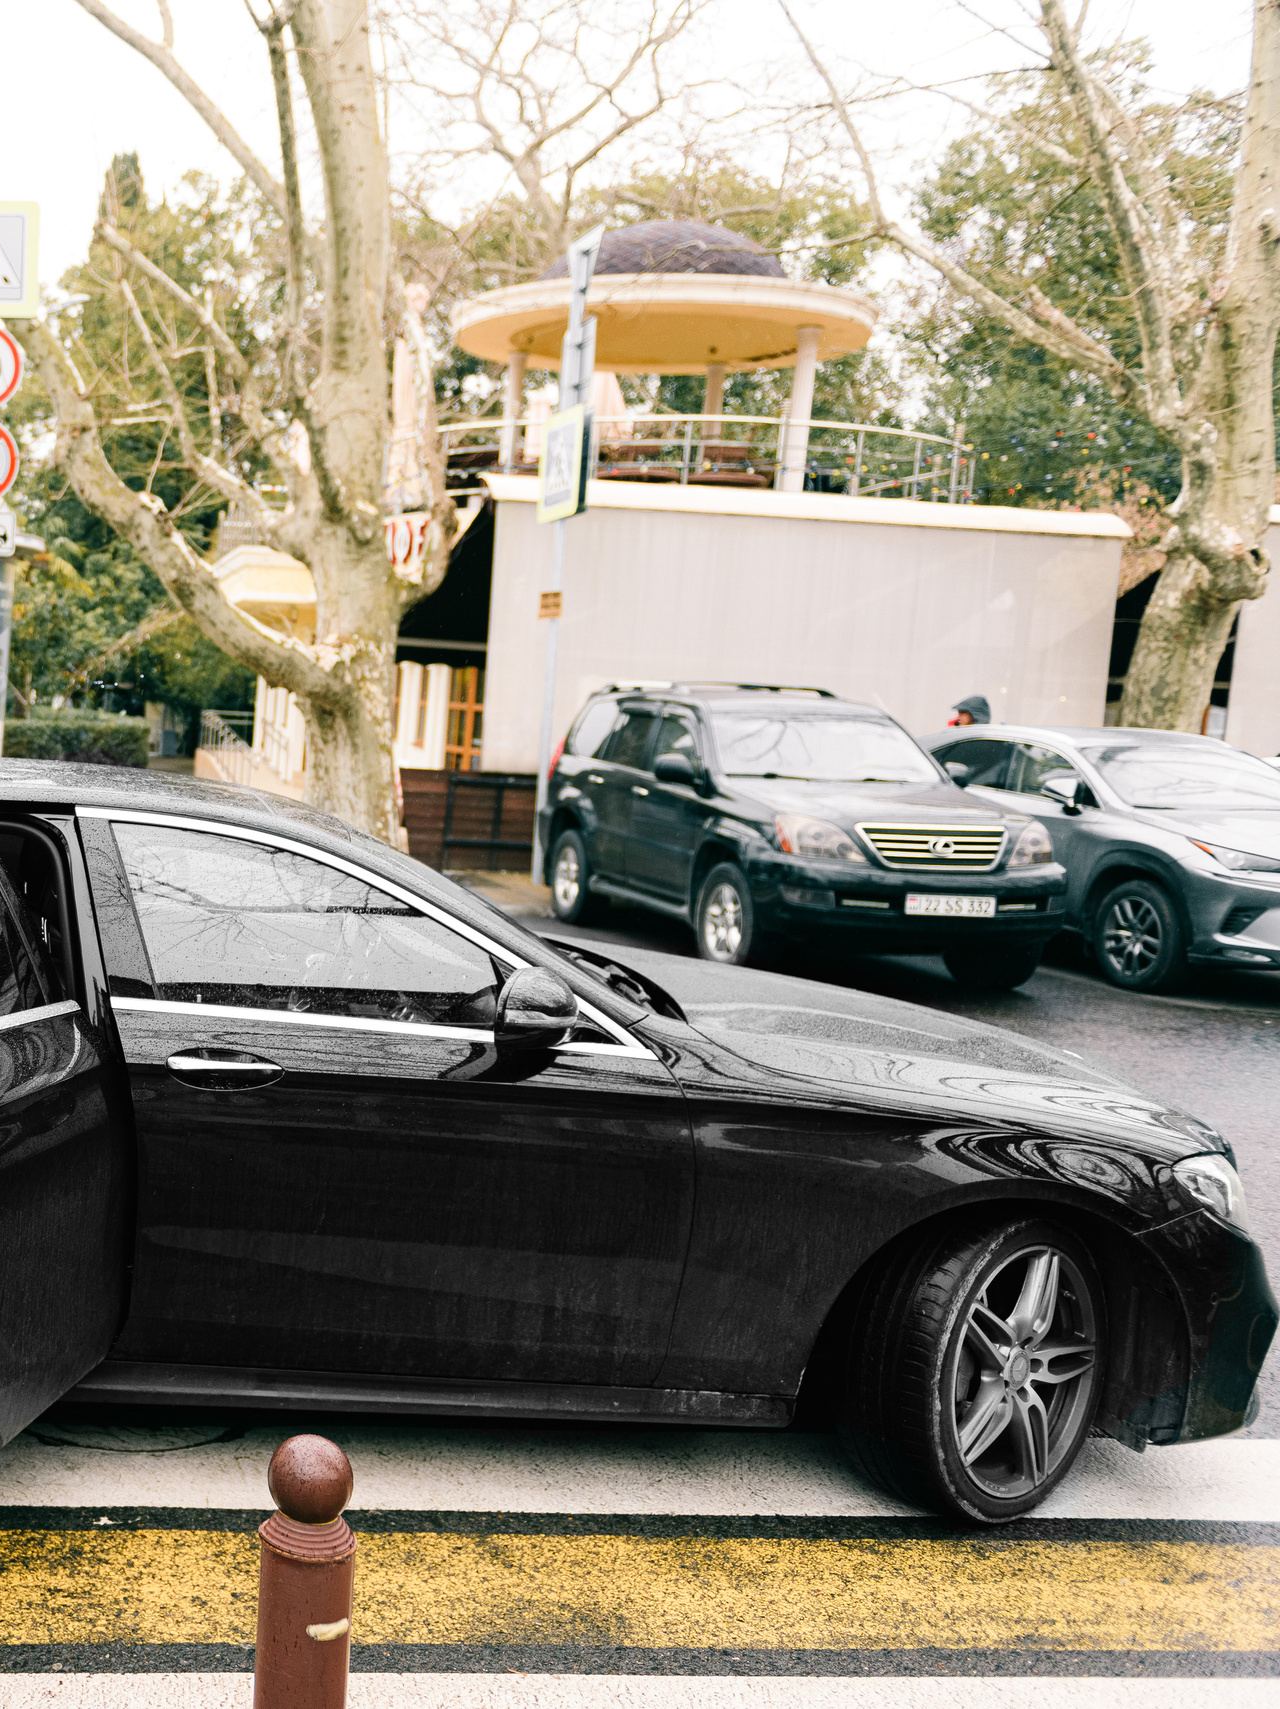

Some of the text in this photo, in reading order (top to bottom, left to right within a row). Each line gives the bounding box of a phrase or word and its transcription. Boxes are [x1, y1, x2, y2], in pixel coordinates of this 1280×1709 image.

[924, 899, 991, 914] 22 SS 332
